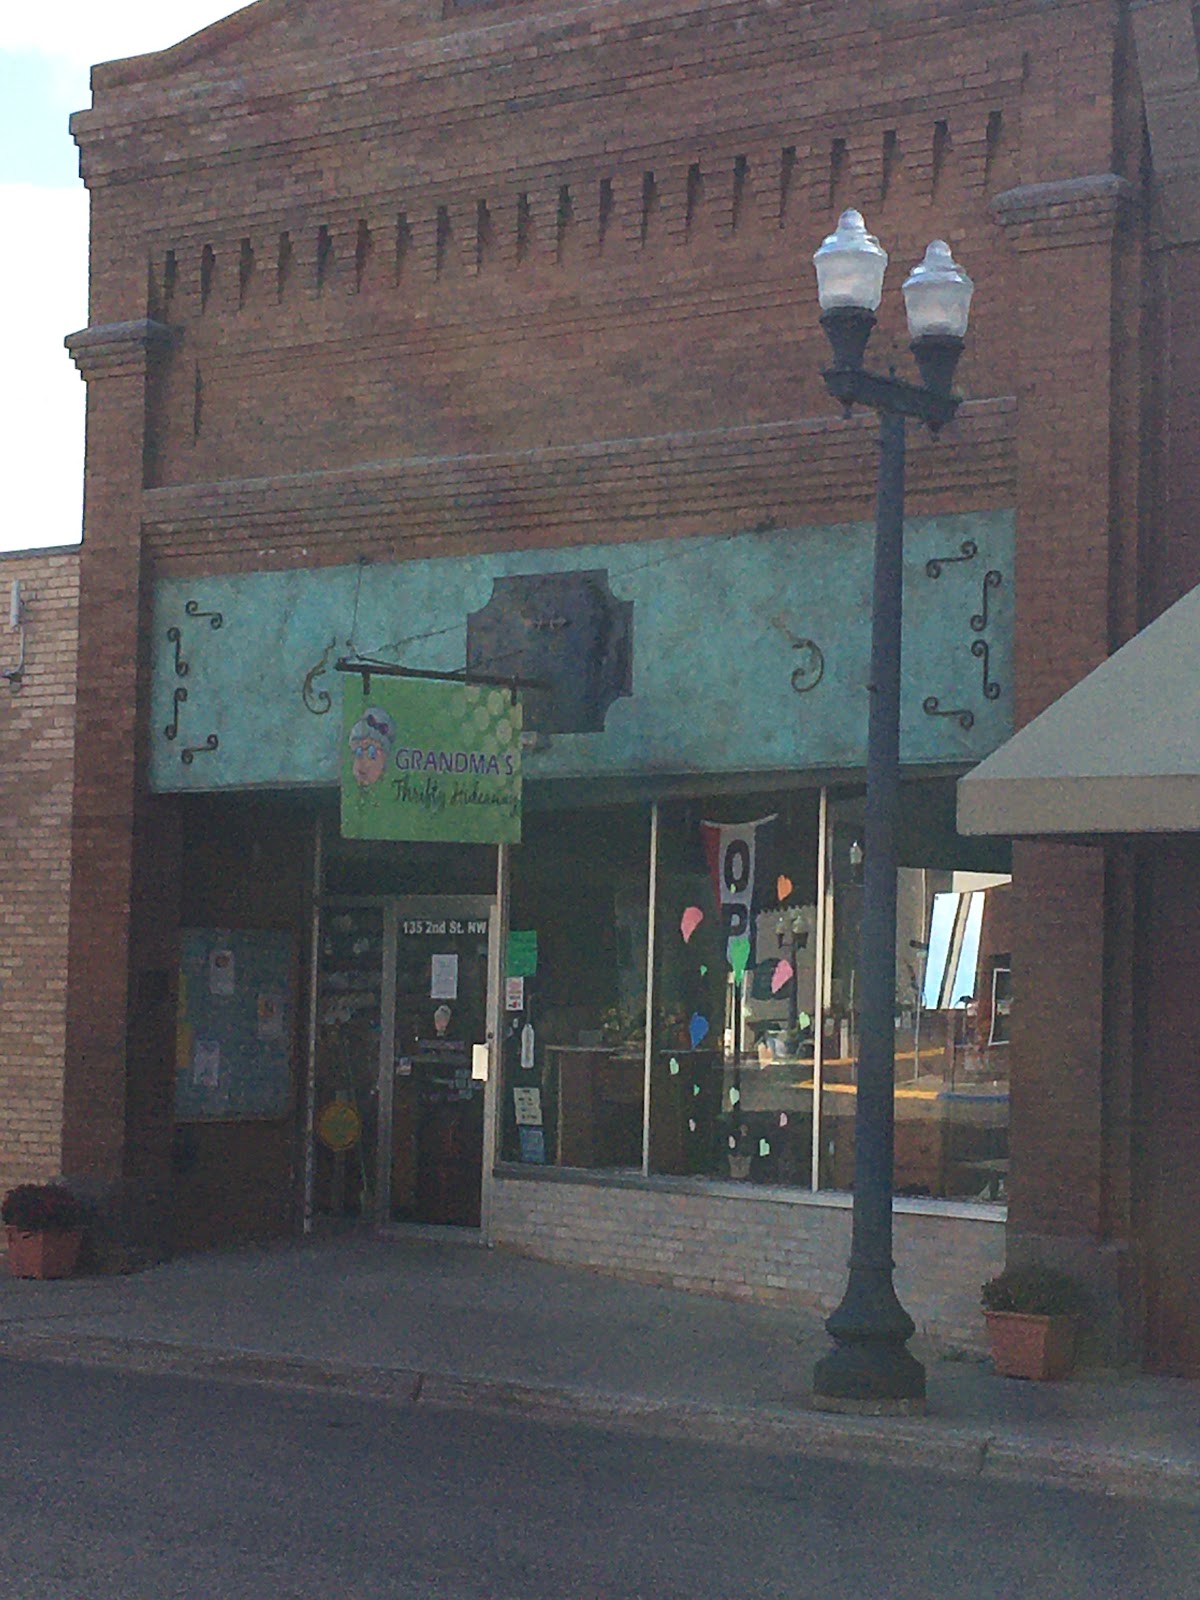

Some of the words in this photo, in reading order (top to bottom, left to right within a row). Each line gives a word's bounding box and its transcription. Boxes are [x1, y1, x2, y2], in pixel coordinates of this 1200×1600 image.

[395, 749, 514, 775] GRANDMA'S
[403, 920, 423, 935] 135
[425, 920, 446, 934] 2nd
[467, 920, 487, 934] NW
